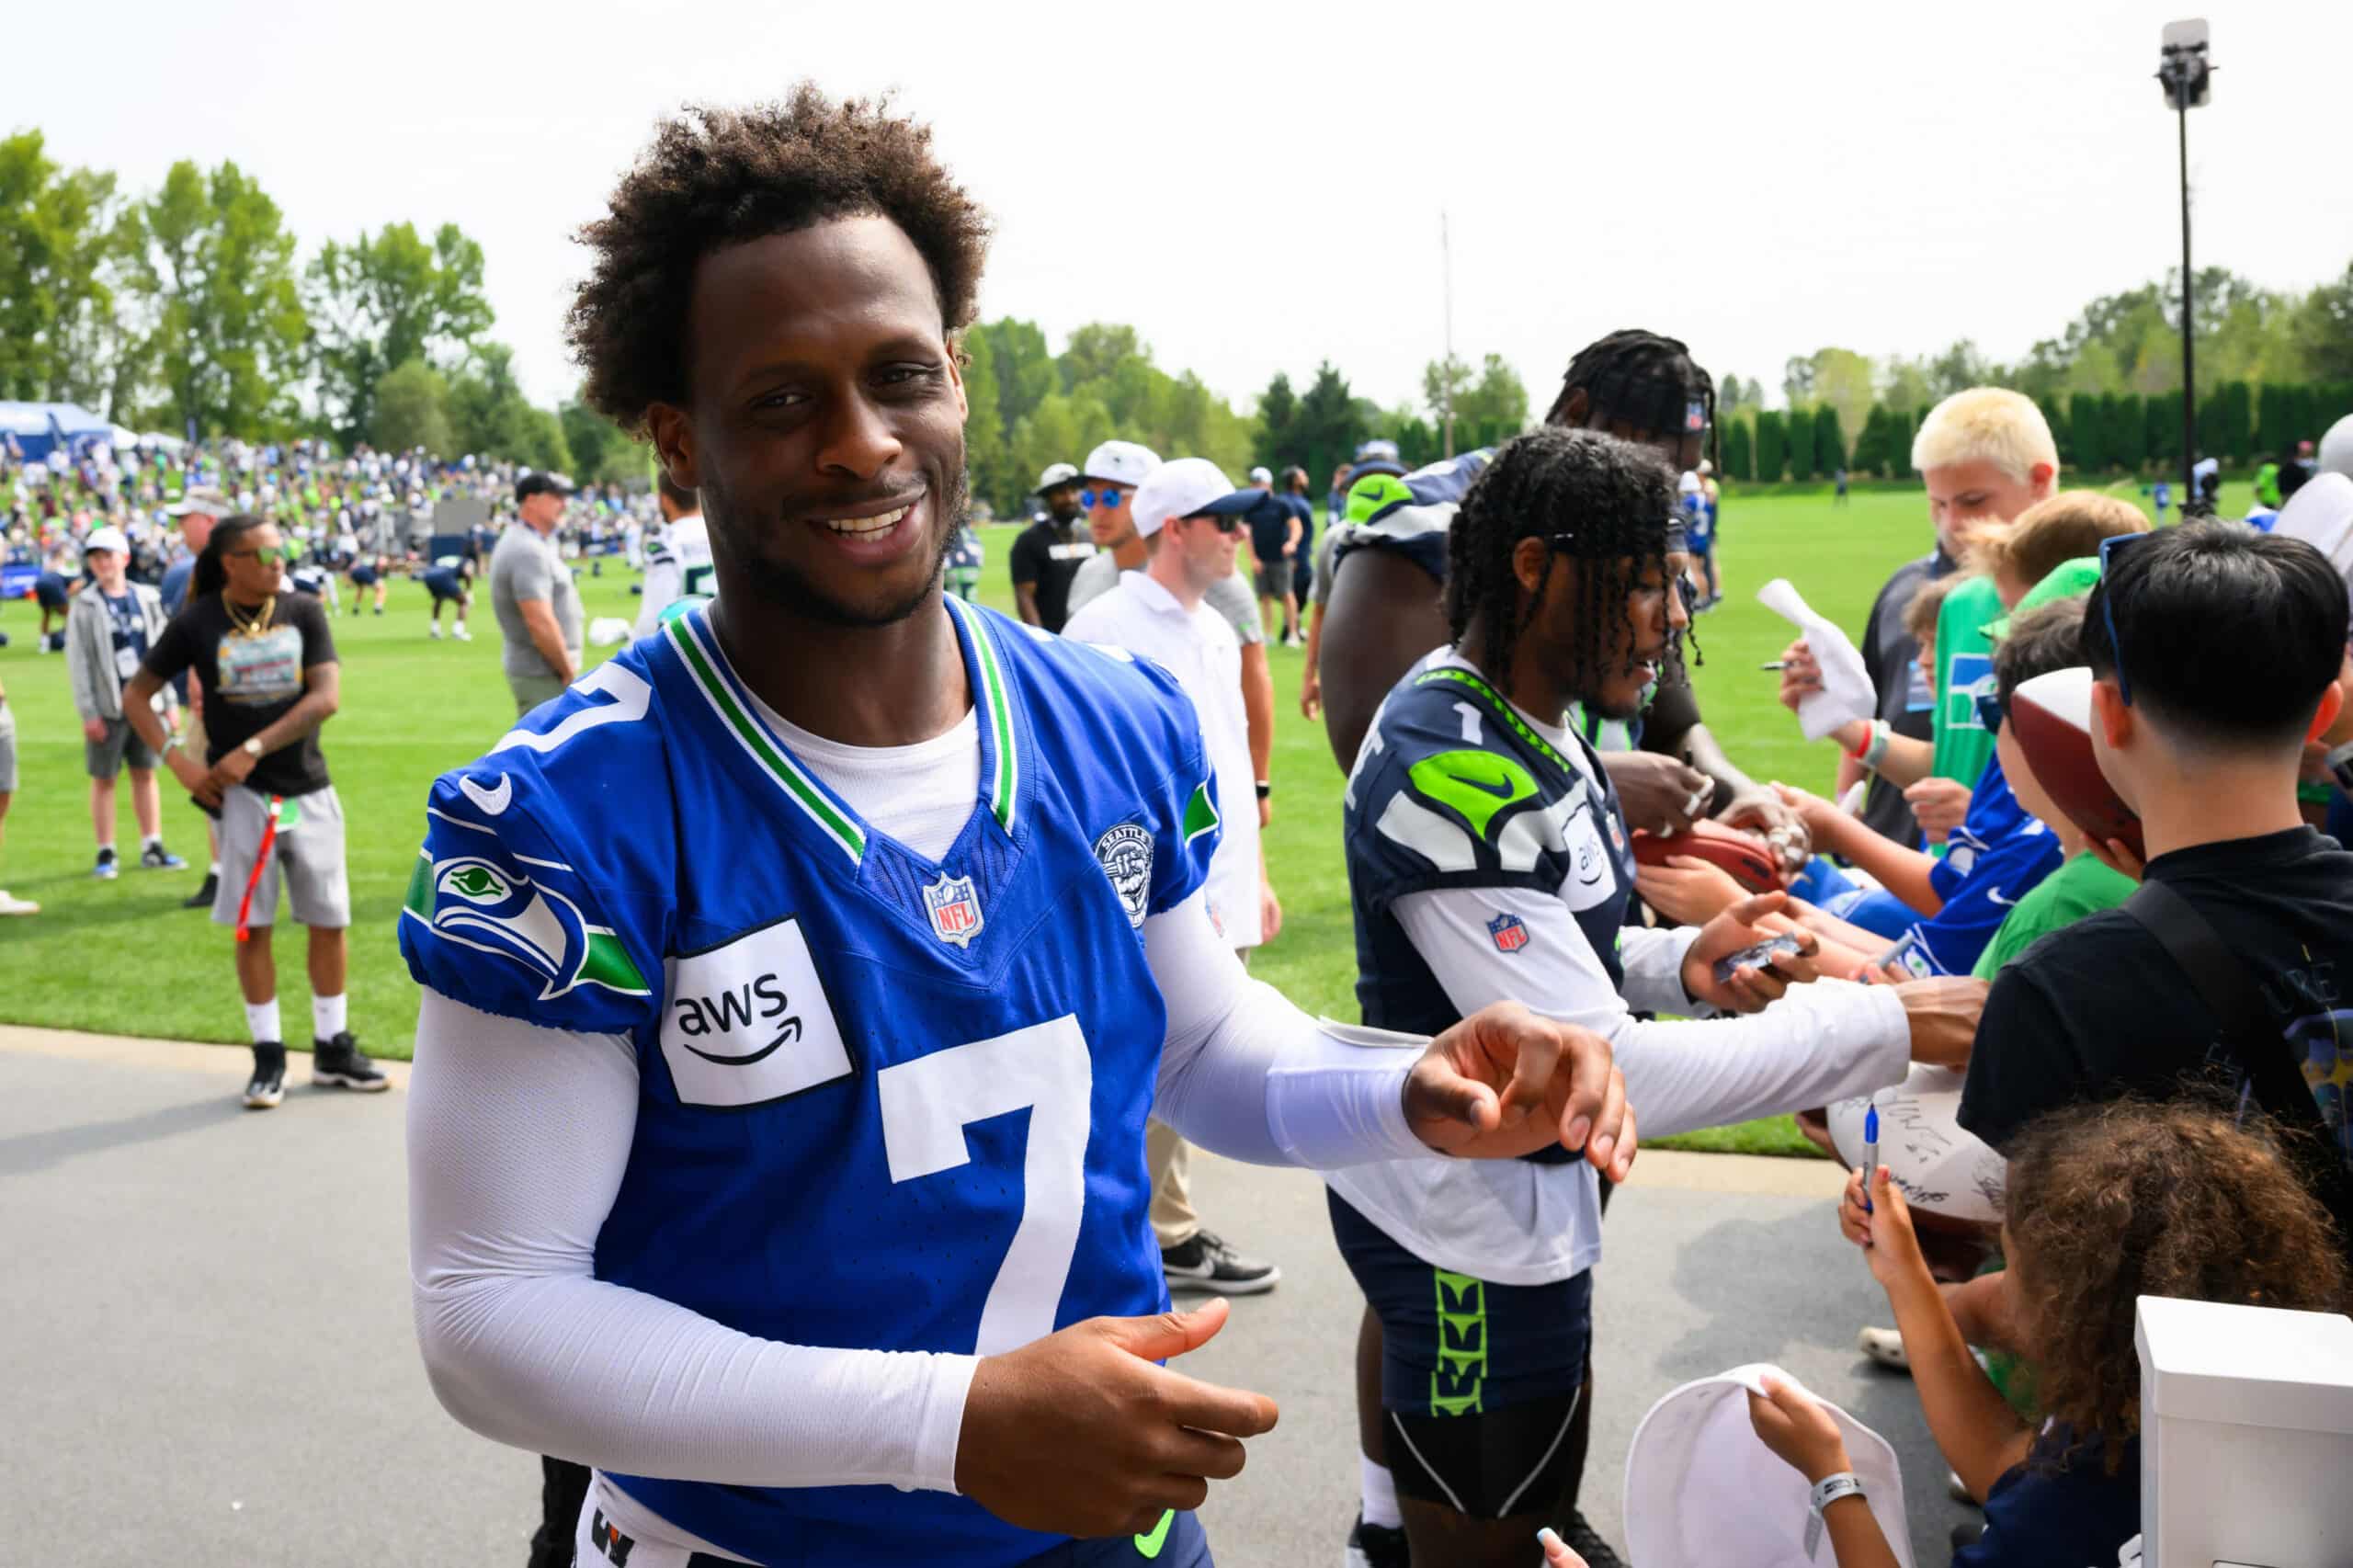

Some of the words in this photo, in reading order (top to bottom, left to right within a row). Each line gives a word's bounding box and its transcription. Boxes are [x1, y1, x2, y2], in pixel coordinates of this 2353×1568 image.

[486, 661, 653, 757] 7
[1452, 701, 1483, 745] 1
[1102, 827, 1147, 851] SEATTLE
[938, 902, 974, 931] NFL
[1496, 926, 1527, 949] NFL
[675, 973, 788, 1037] aws
[877, 1012, 1093, 1358] 7
